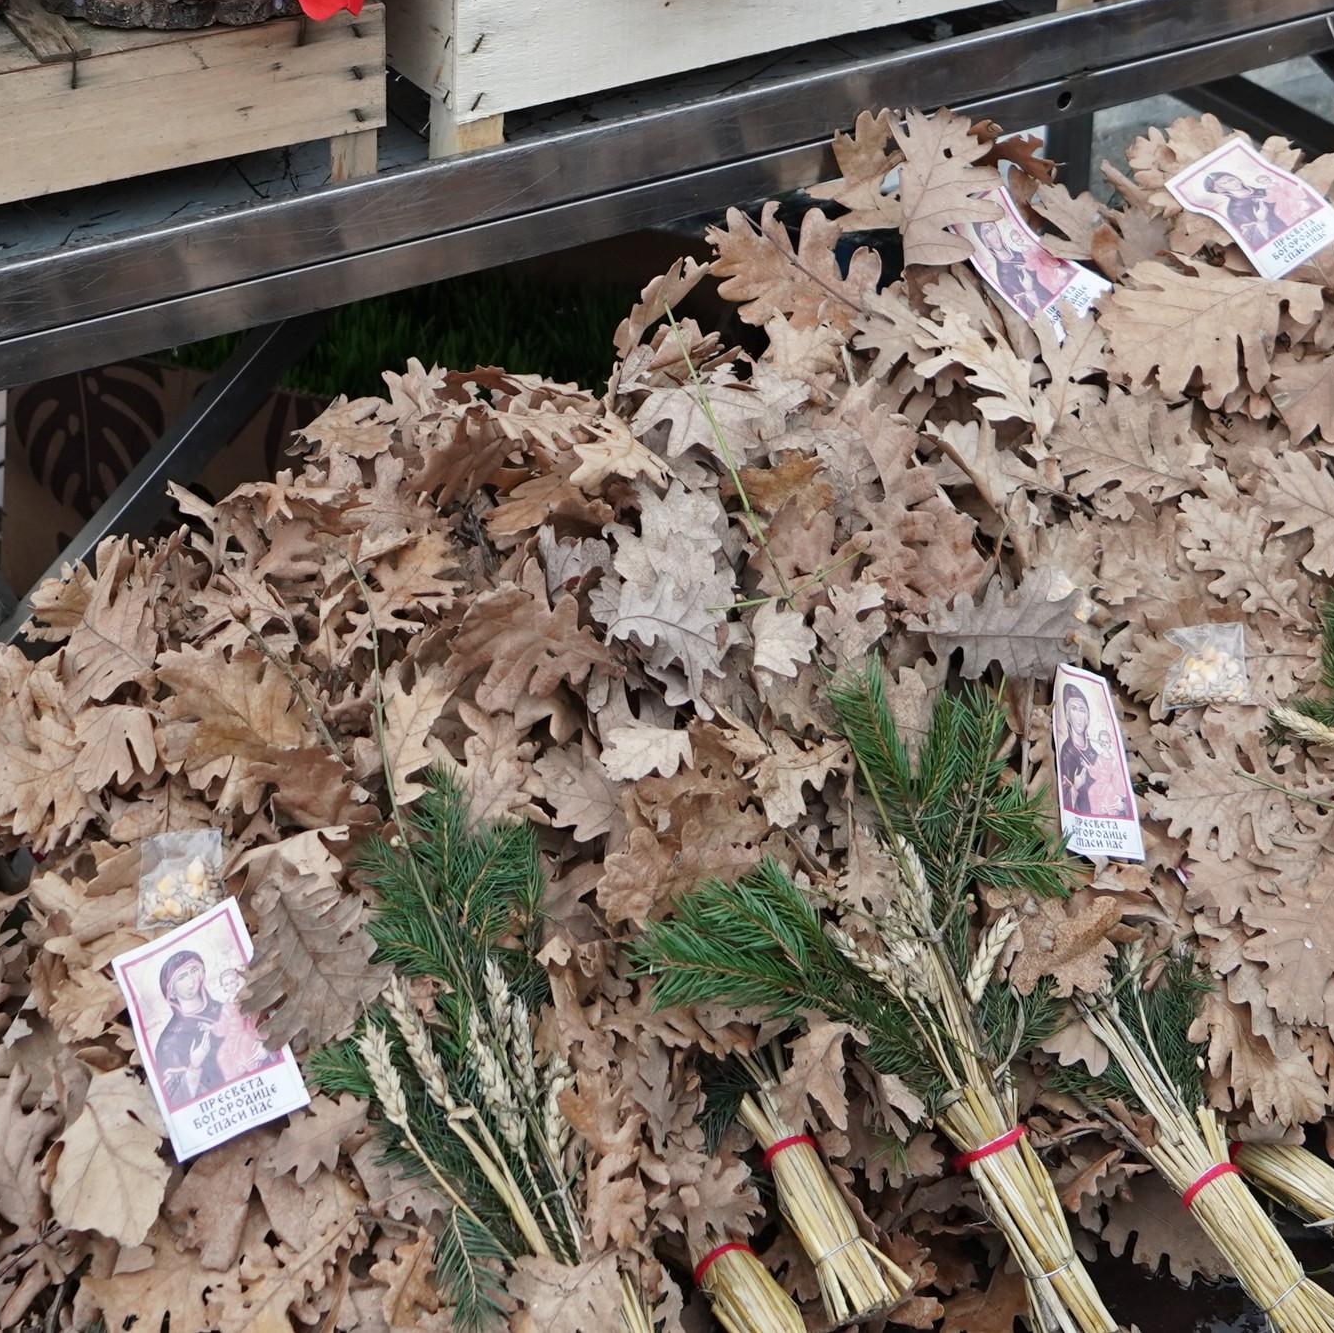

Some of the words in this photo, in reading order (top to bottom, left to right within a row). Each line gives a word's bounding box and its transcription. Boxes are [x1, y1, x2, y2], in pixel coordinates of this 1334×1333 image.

[1271, 220, 1327, 261] БОГОРОДИЦЕ
[1273, 219, 1315, 249] ПРЕСВЕТА
[1283, 242, 1311, 263] СПАСИ
[1310, 230, 1328, 244] НАС
[1046, 285, 1076, 315] ПРЕТА
[1050, 285, 1088, 326] БОГДИЦЕ
[1071, 824, 1128, 840] БОГОРОДИЦЕ
[1074, 816, 1119, 830] ПРЕСВЕТА
[1075, 837, 1104, 848] СПАСИ
[1105, 839, 1124, 850] НАС
[193, 1083, 278, 1129] БОГОРОДИЦЕ
[199, 1076, 264, 1113] ПРЕСВЕТА
[206, 1111, 248, 1136] СПАСИ
[250, 1098, 274, 1116] НАС
